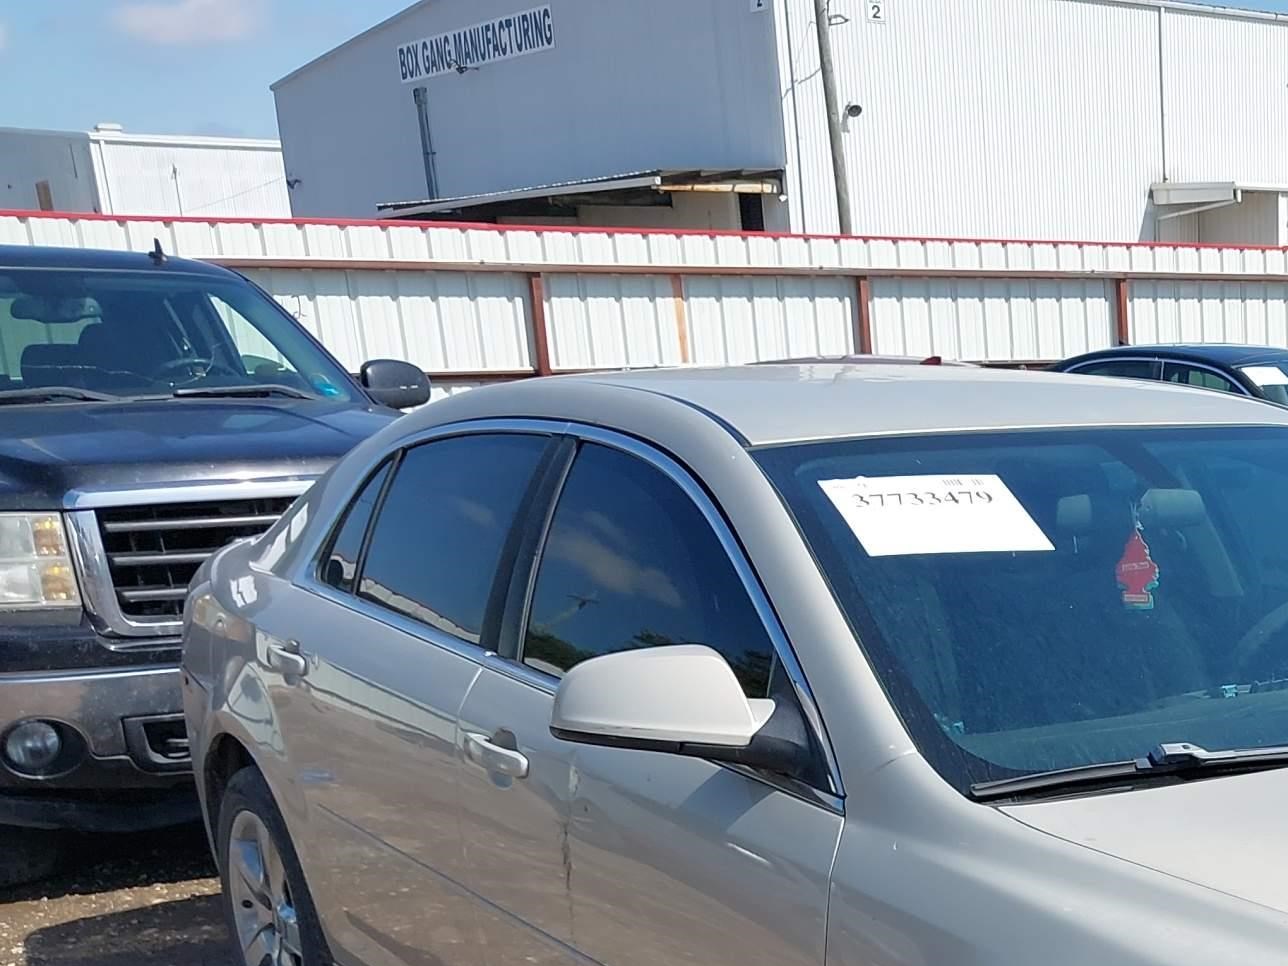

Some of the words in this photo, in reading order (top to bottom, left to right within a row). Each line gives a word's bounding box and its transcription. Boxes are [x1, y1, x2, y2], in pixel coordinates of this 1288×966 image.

[871, 4, 881, 19] 2
[398, 43, 422, 80] BOX
[421, 35, 453, 75] GANG
[452, 8, 554, 67] MANUFACTURING
[851, 490, 994, 508] 37733479
